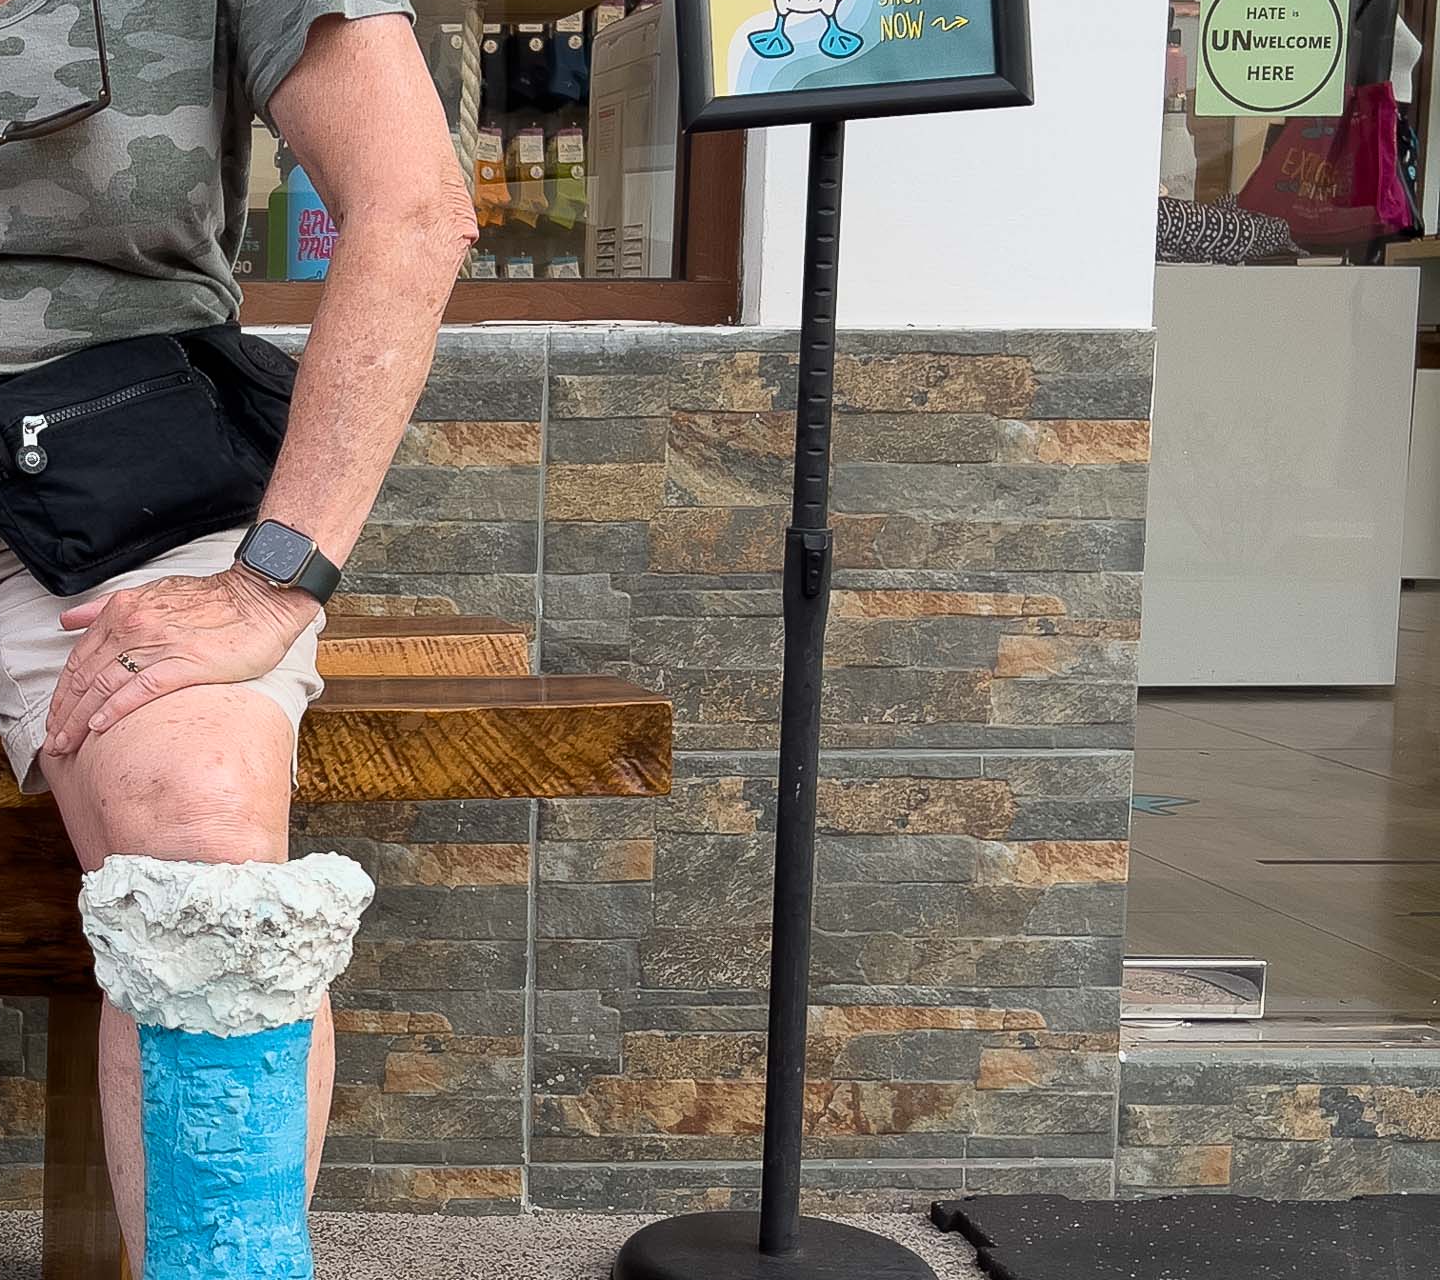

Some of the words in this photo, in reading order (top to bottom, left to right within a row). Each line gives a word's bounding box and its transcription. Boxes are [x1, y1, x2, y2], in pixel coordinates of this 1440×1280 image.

[1246, 7, 1286, 20] HATE
[879, 11, 925, 42] NOW
[1211, 30, 1332, 51] UNWELCOME
[1247, 66, 1295, 81] HERE
[297, 237, 339, 262] PAG
